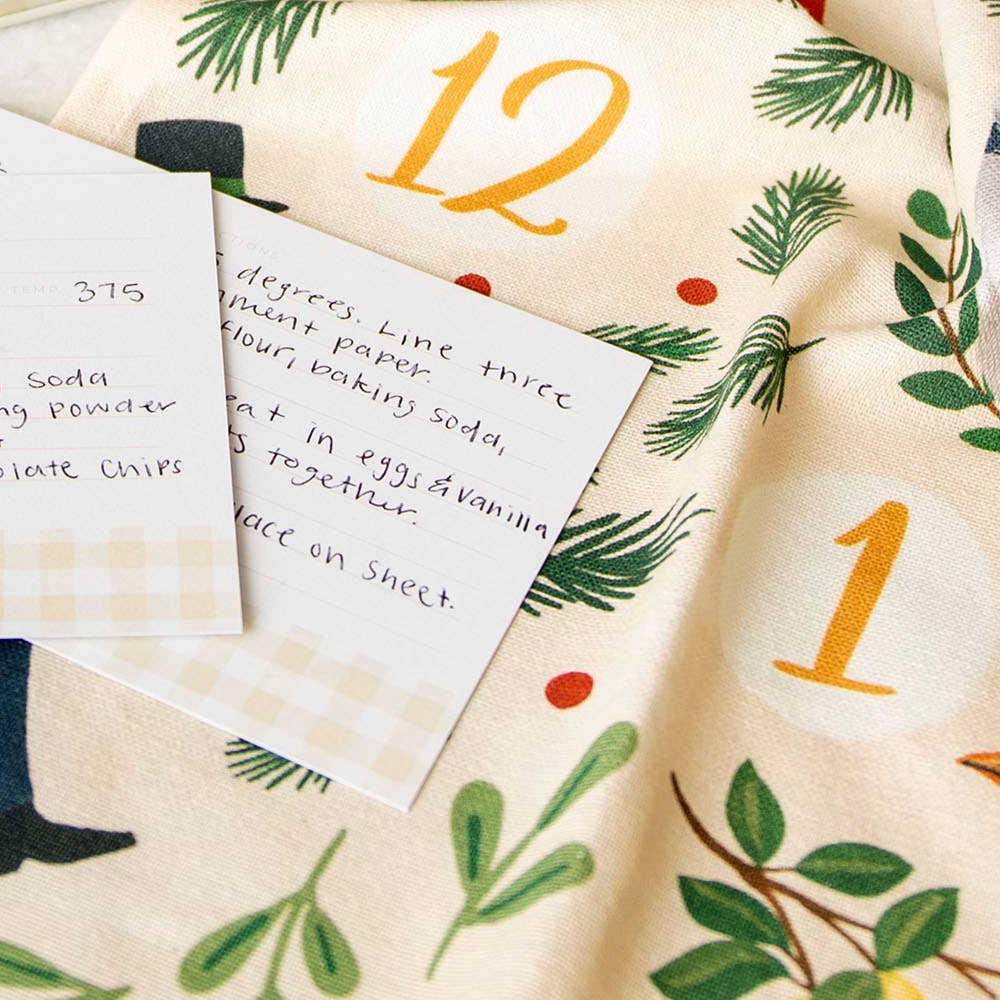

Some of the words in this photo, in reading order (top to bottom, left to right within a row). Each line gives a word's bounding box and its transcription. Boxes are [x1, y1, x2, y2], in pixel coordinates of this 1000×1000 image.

[366, 29, 631, 236] 12
[74, 281, 146, 303] 375
[237, 265, 362, 324] degrees.
[481, 360, 573, 410] three
[332, 336, 433, 384] paper.
[49, 397, 178, 420] powder
[226, 394, 286, 422] eat
[306, 421, 335, 454] in
[357, 448, 423, 489] eggs
[311, 359, 417, 419] baking
[429, 408, 506, 456] soda,
[267, 447, 418, 525] together.
[233, 502, 295, 548] lace
[310, 542, 345, 571] on
[771, 500, 910, 696] 1
